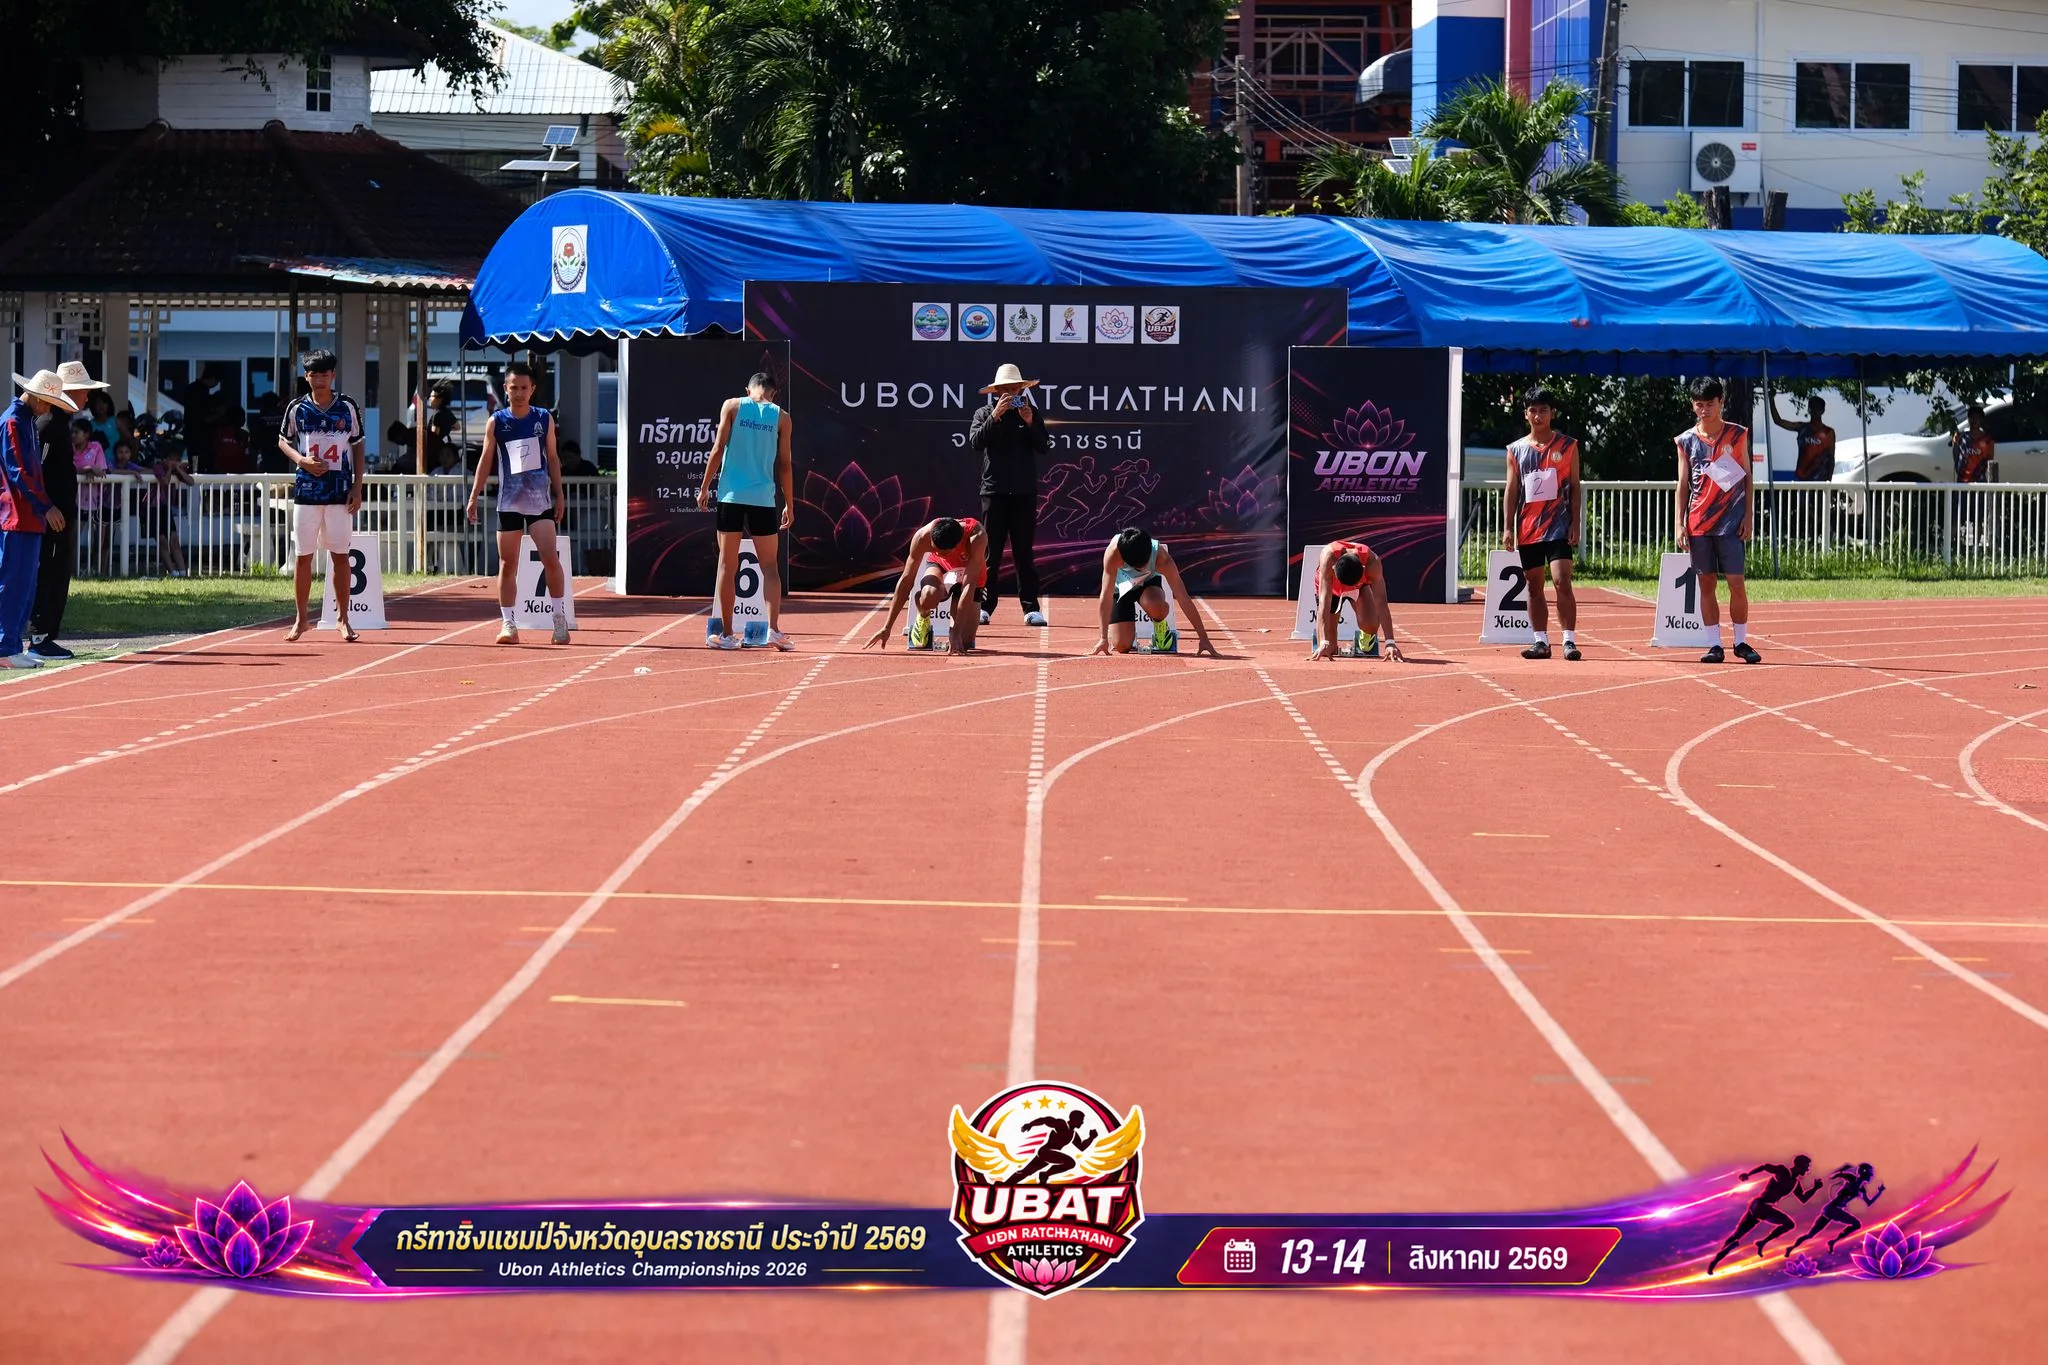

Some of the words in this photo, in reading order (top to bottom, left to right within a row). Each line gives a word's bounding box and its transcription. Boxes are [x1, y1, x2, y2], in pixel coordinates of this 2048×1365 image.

[1147, 325, 1174, 333] UBAT
[841, 382, 964, 409] UBON
[639, 417, 720, 443] กรีฑาชิง
[309, 444, 340, 463] 14
[516, 444, 532, 464] 7
[656, 451, 711, 469] จ.อุบลร
[1314, 451, 1427, 475] UBON
[1317, 478, 1420, 490] ATHLETICS
[1533, 477, 1544, 496] 2
[530, 551, 560, 597] 7
[735, 552, 759, 598] 6
[1498, 565, 1528, 611] 2
[1675, 567, 1695, 614] 1
[524, 599, 554, 613] Nelc
[733, 602, 759, 615] elco
[929, 607, 951, 619] elc
[1494, 615, 1529, 629] Nelco
[1665, 616, 1699, 630] Nelco
